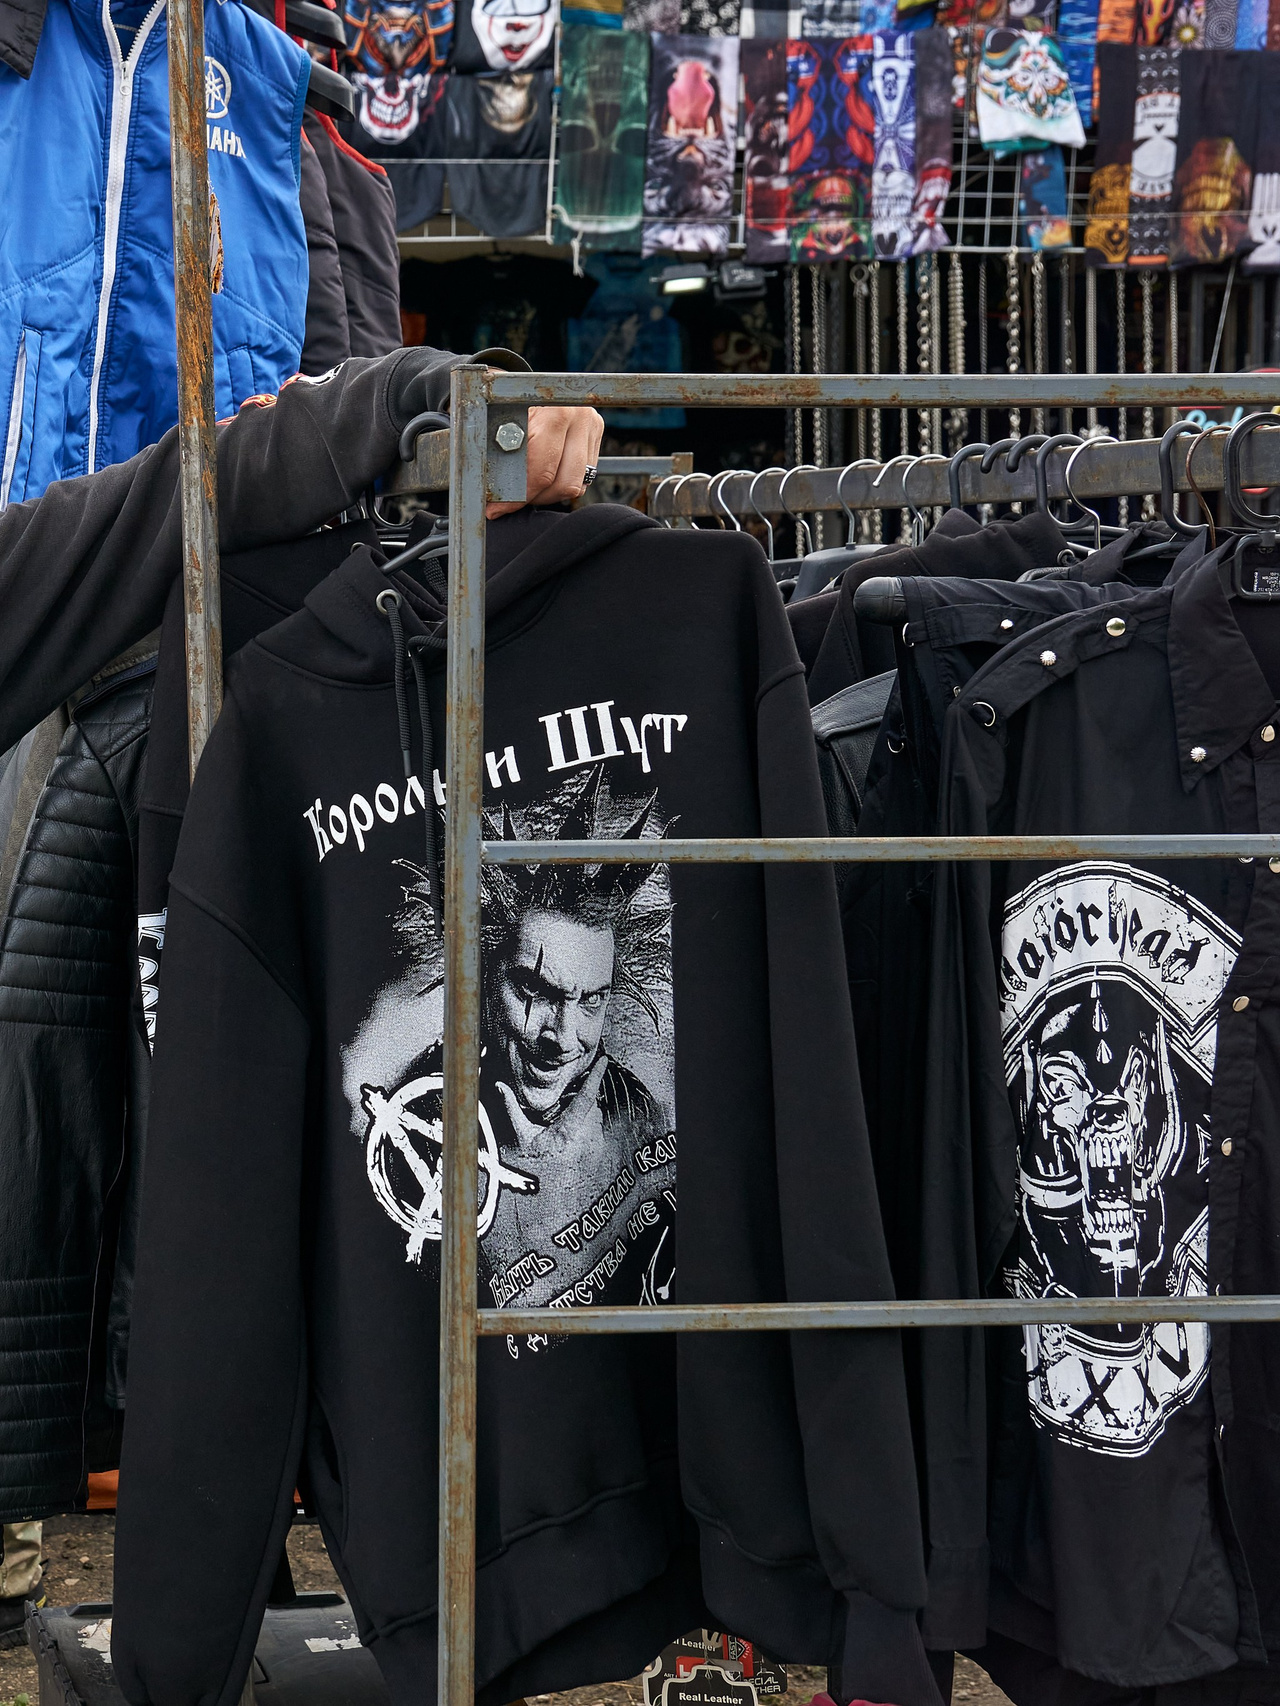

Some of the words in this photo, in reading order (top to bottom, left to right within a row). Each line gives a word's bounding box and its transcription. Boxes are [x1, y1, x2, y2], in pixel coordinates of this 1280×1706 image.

[538, 700, 688, 773] Шут
[744, 1676, 779, 1687] ECIAL
[679, 1692, 701, 1702] Real
[704, 1693, 743, 1705] Leather
